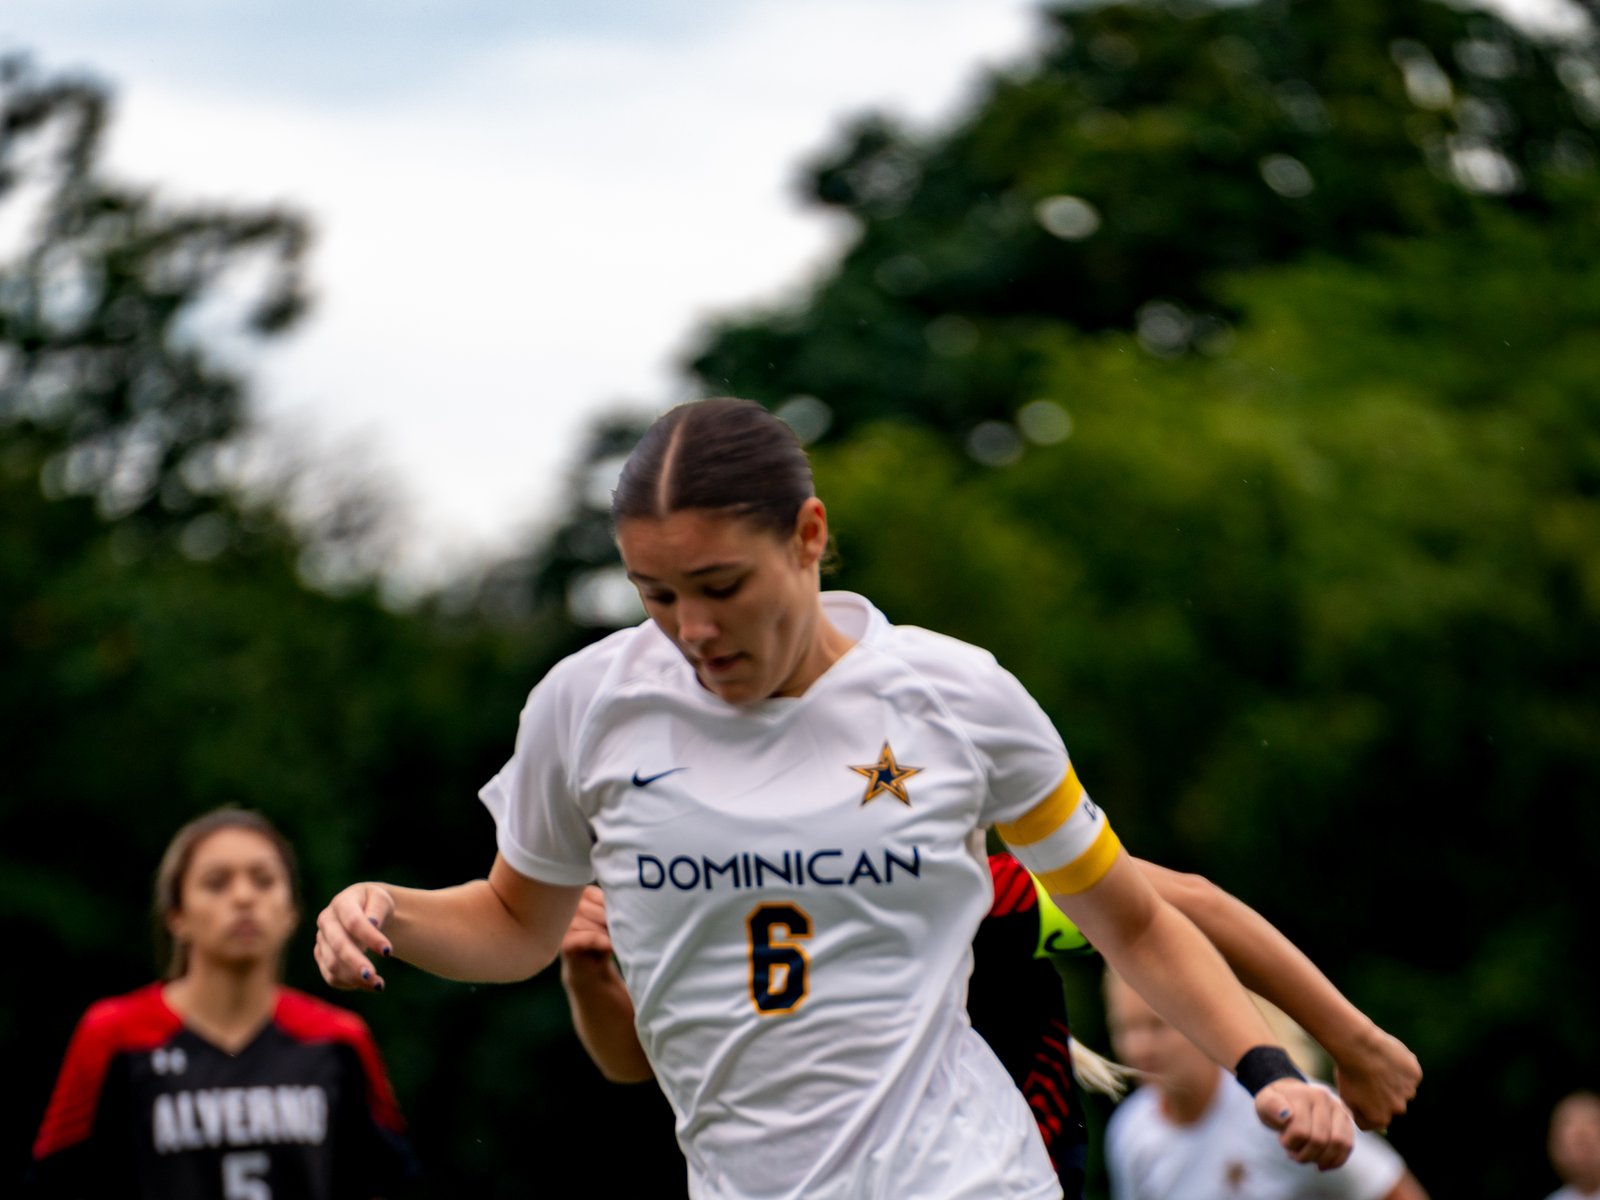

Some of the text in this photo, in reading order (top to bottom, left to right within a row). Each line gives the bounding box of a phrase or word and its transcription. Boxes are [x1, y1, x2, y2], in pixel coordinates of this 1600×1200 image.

[637, 846, 921, 890] DOMINICAN
[745, 901, 814, 1016] 6
[153, 1084, 328, 1154] ALVERNO
